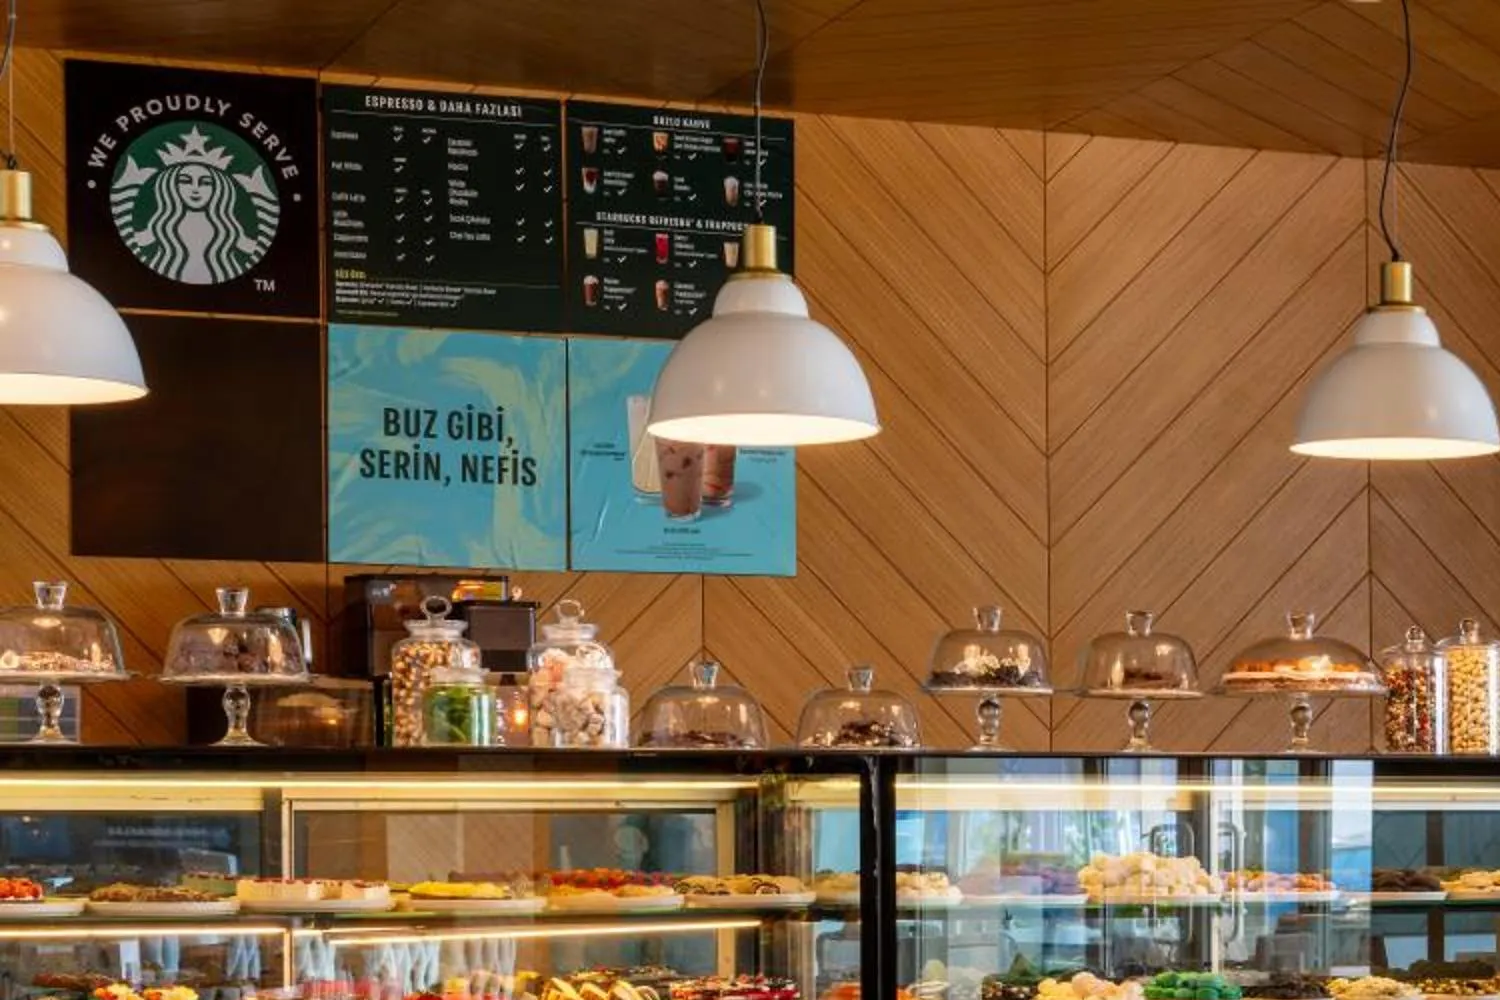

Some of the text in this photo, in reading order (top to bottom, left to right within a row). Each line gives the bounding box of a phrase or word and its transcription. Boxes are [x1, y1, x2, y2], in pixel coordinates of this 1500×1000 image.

[364, 95, 423, 111] ESPRESSO
[439, 100, 471, 113] DAHA
[87, 94, 300, 180] WE PROUDLY SERVE
[254, 279, 276, 292] TM
[383, 404, 513, 448] BUZ GİBİ,
[360, 444, 451, 487] SERİN,
[461, 450, 537, 486] NEFİS
